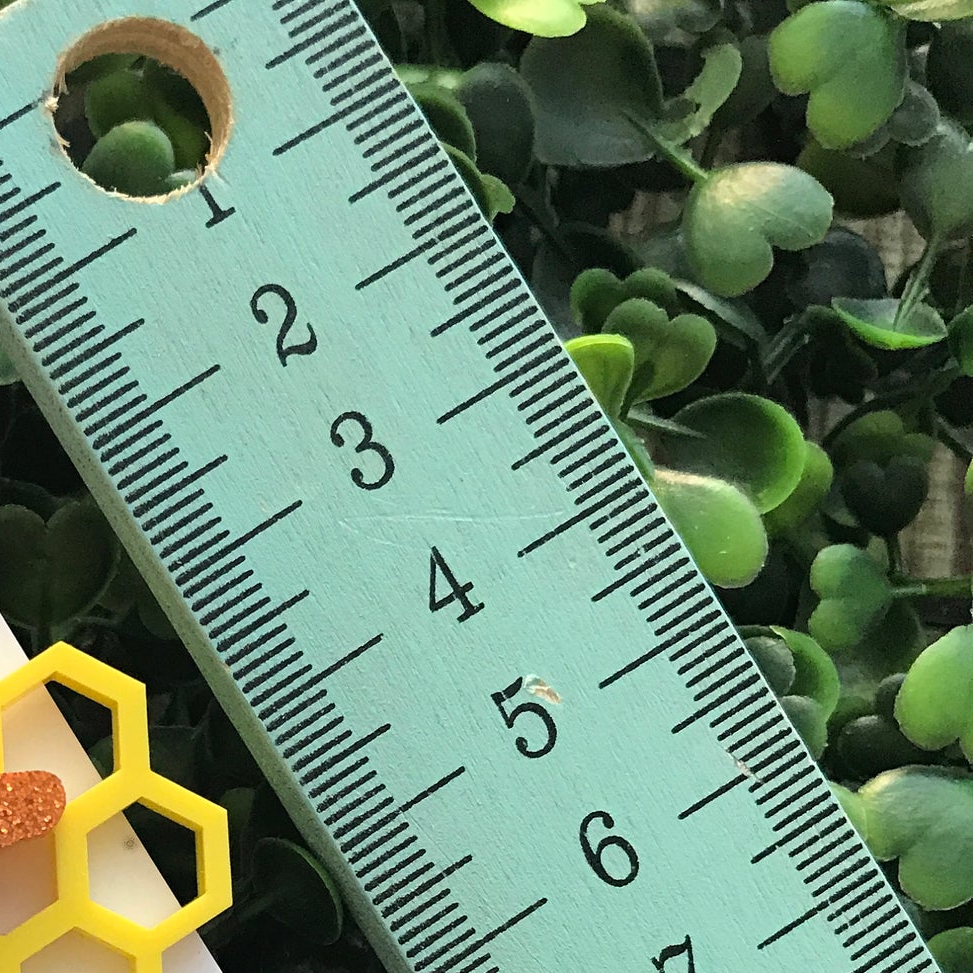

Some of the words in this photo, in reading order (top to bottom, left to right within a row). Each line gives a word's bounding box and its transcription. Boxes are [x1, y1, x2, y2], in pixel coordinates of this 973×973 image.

[250, 284, 318, 366] 2
[330, 412, 395, 490] 3
[428, 547, 484, 622] 4
[490, 677, 558, 758] 5
[579, 811, 640, 886] 6
